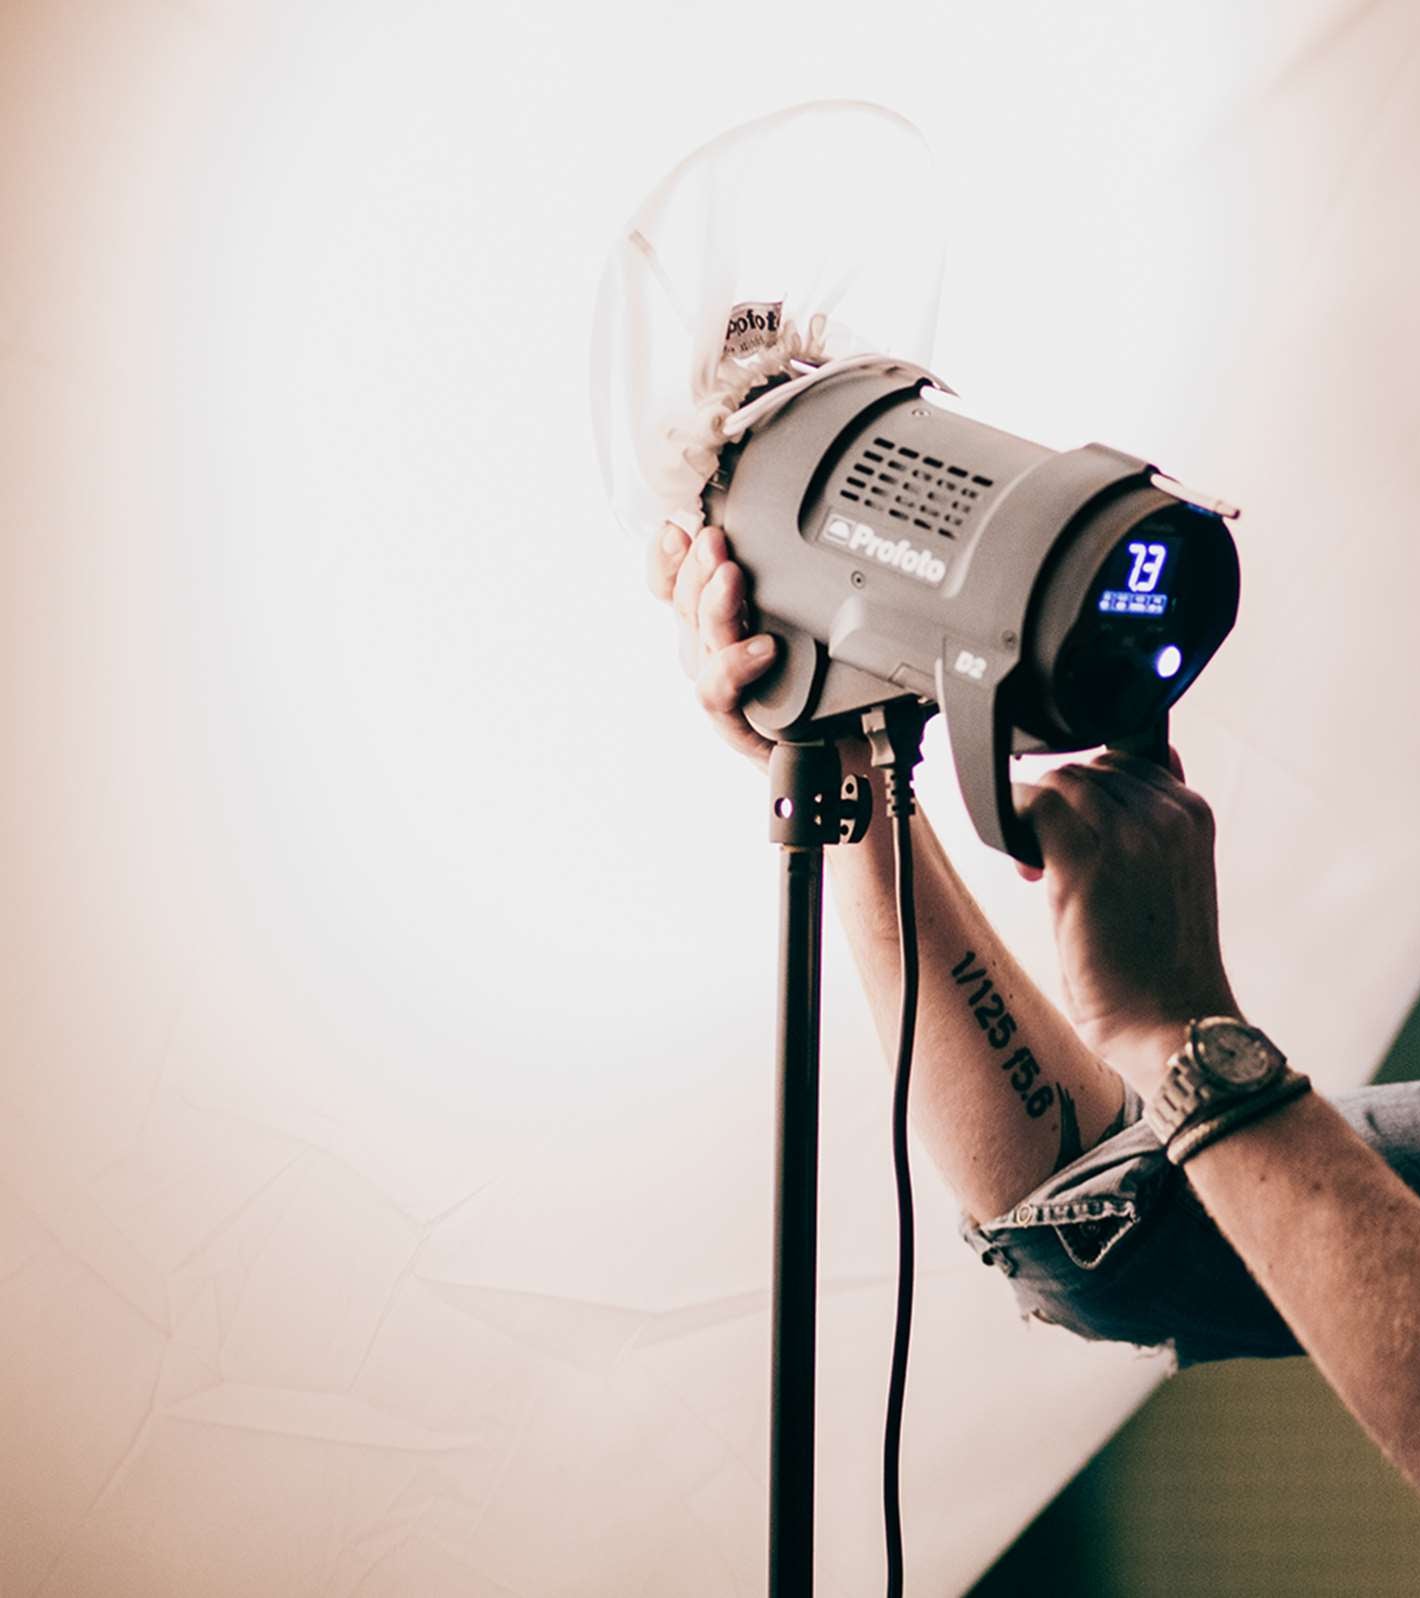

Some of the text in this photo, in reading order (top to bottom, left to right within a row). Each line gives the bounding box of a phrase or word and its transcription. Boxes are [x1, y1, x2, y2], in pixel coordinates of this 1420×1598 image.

[848, 523, 946, 583] Profoto
[955, 651, 987, 679] D2
[952, 951, 1054, 1119] 1/125 f5.6
